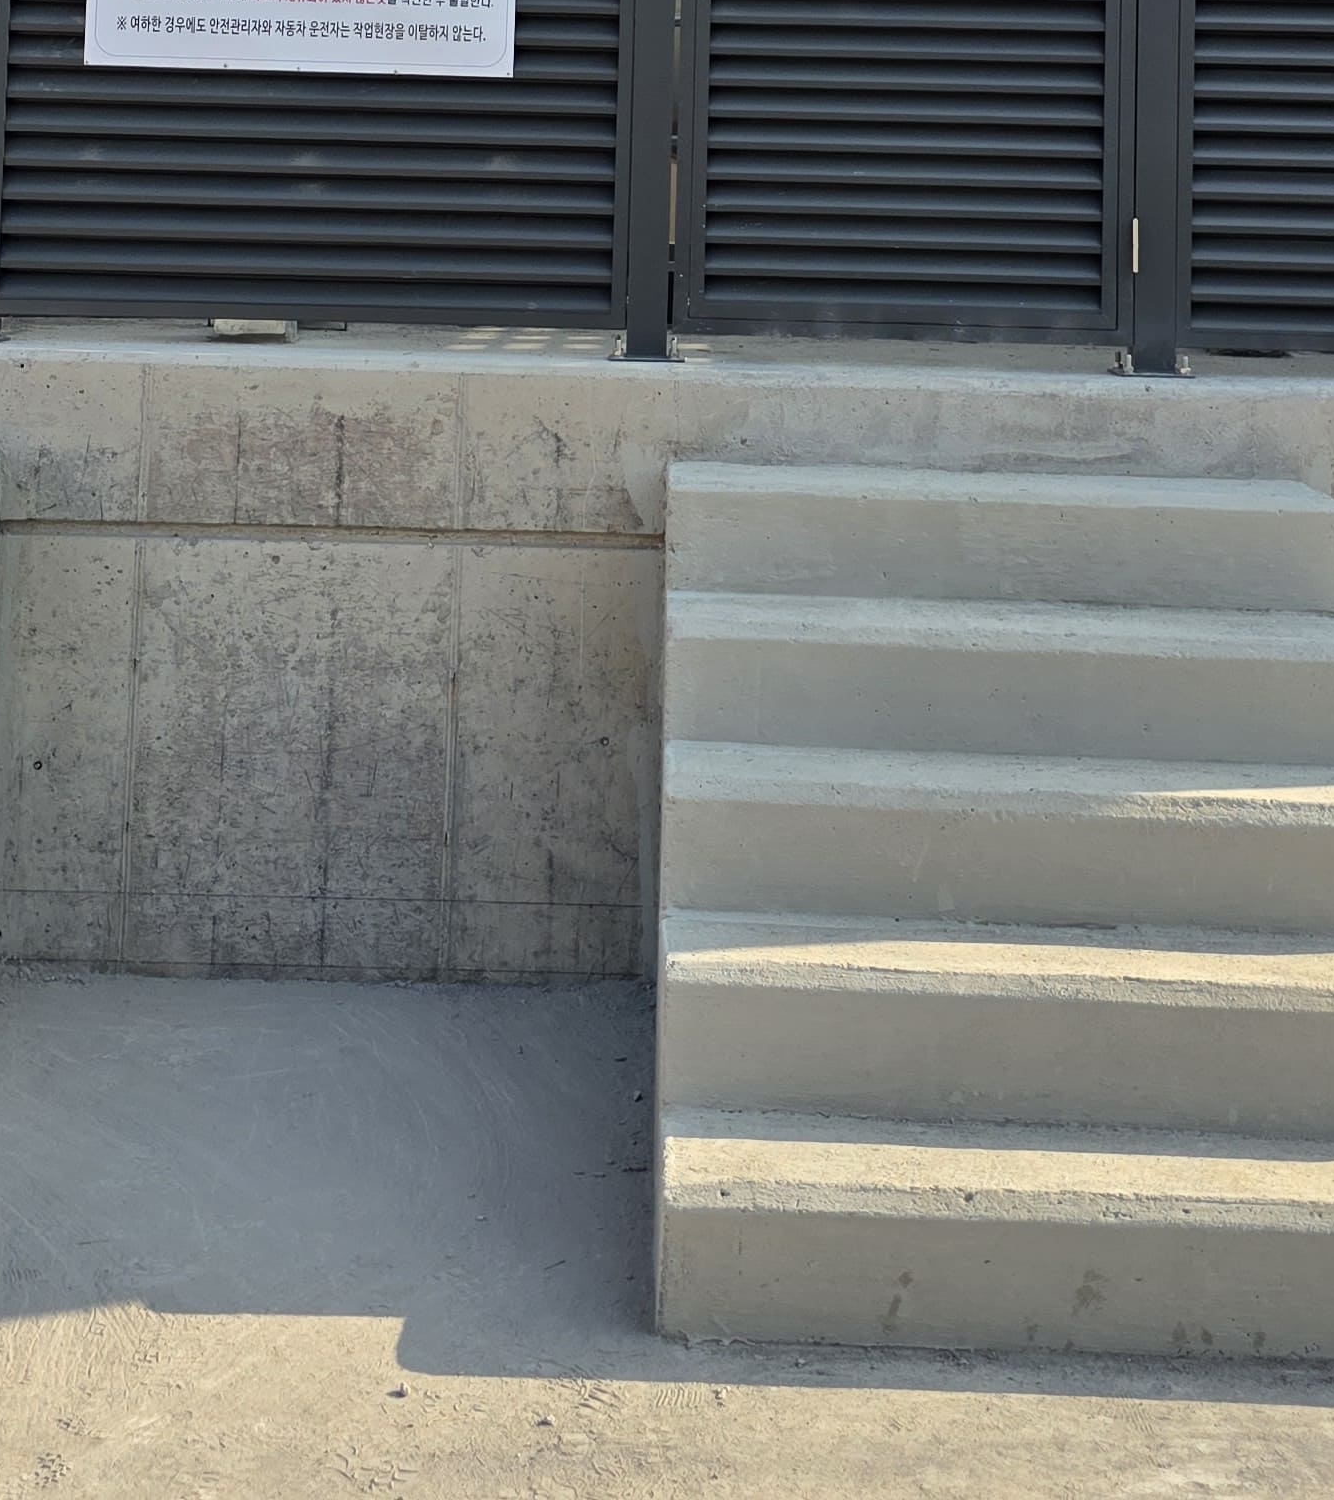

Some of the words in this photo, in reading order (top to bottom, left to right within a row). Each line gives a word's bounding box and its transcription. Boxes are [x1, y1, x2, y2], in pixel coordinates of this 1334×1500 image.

[130, 15, 162, 33] 여하한
[165, 16, 206, 34] 경우에도
[209, 17, 272, 36] 안전관리자와
[274, 20, 306, 37] 자동차
[309, 20, 351, 39] 운전자는
[353, 22, 405, 40] 작업현장을
[408, 23, 449, 42] 이탈하지
[452, 25, 486, 43] 않는다.
